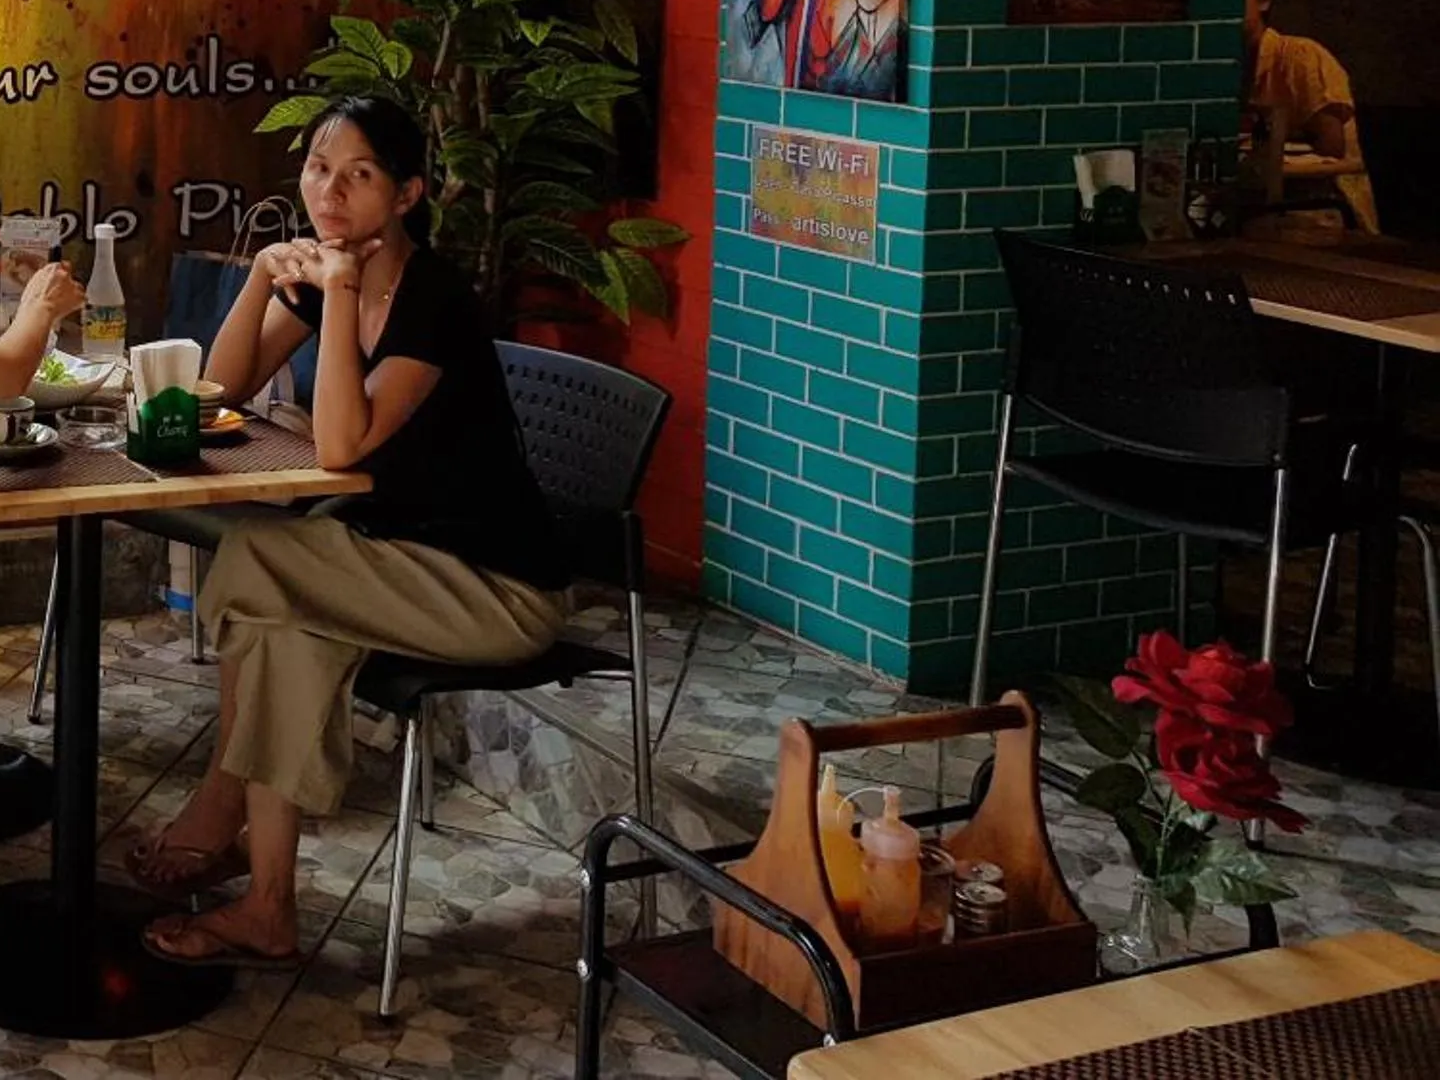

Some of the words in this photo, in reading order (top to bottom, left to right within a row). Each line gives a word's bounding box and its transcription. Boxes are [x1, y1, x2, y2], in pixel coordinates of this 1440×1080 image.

[758, 138, 812, 167] FREE
[816, 147, 870, 177] Wi-Fi
[791, 216, 870, 245] artislove
